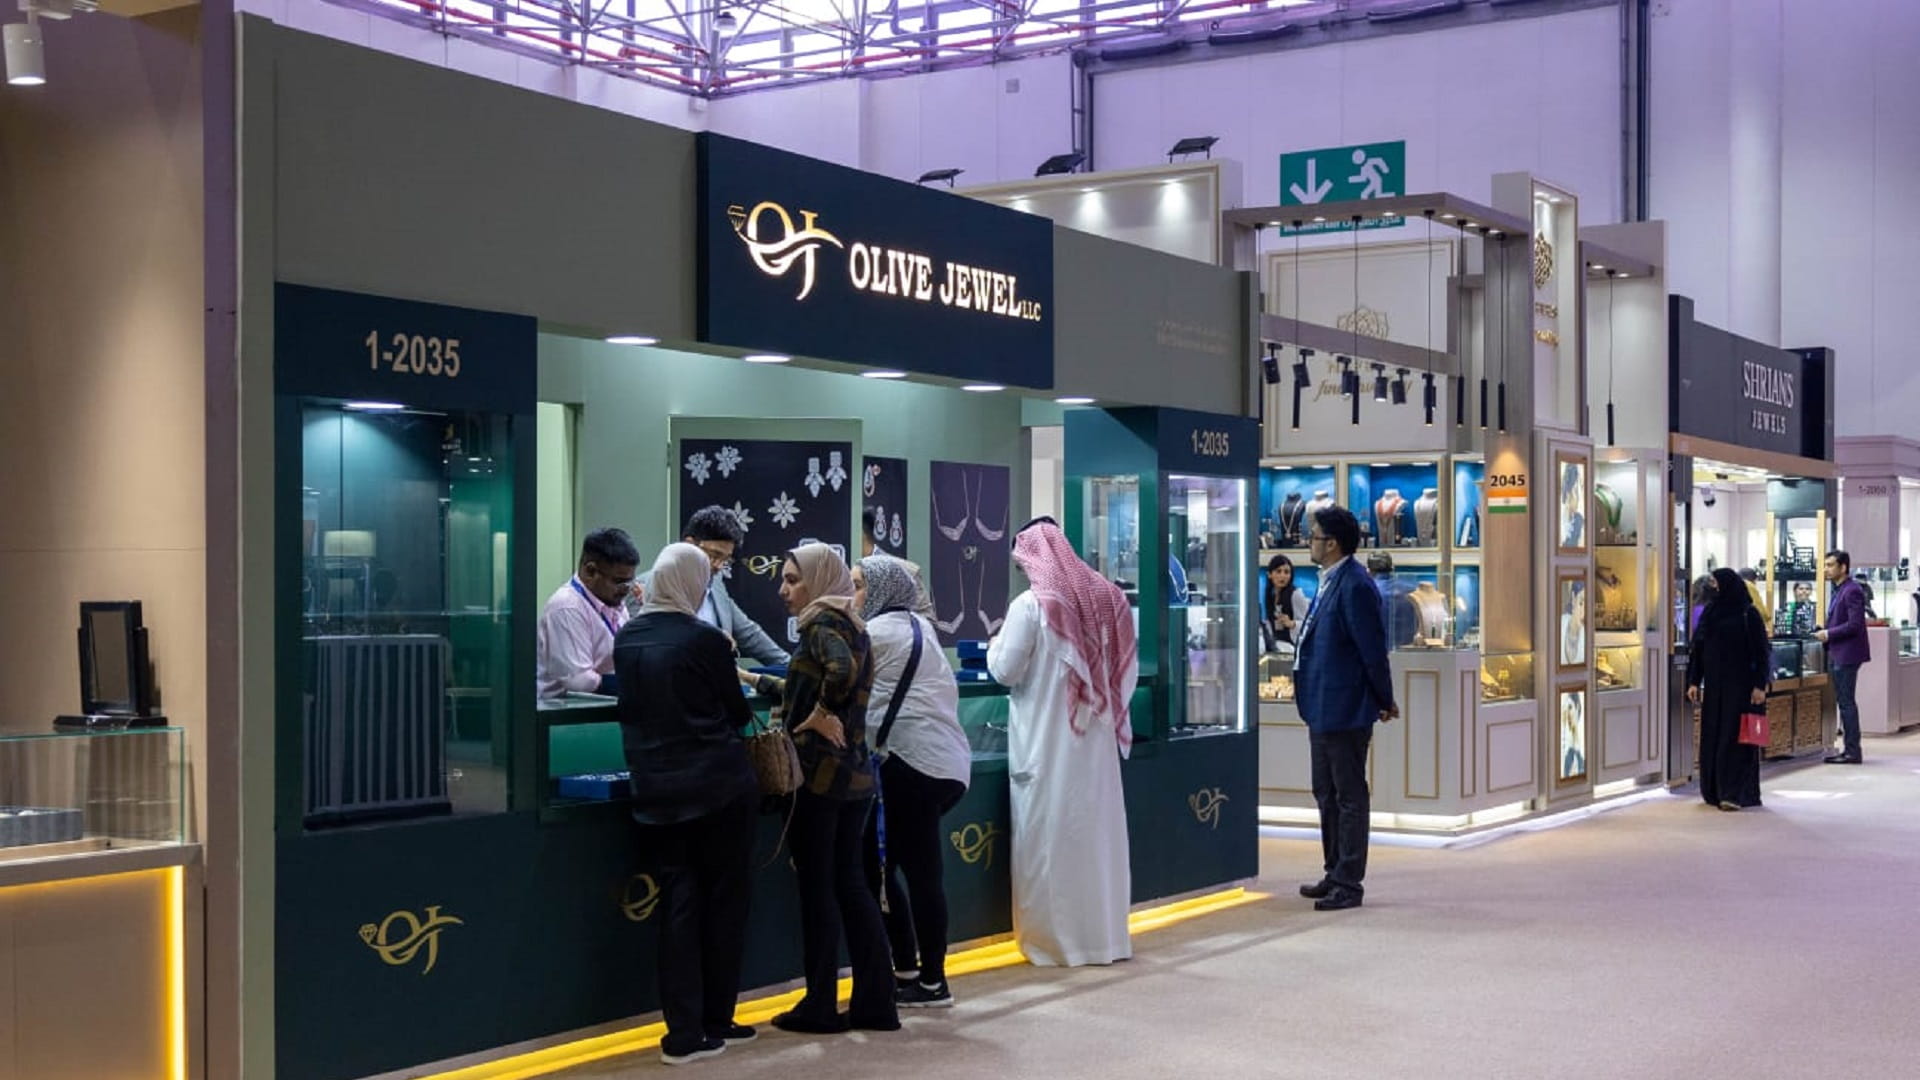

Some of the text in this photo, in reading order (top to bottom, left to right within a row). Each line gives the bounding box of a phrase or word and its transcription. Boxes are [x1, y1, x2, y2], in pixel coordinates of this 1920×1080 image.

[850, 242, 1041, 321] OLIVE JEWEL LLC
[366, 330, 461, 377] 1-2035
[1752, 410, 1786, 434] JEWELS
[1191, 429, 1229, 456] 1-2035
[1490, 474, 1526, 487] 2045
